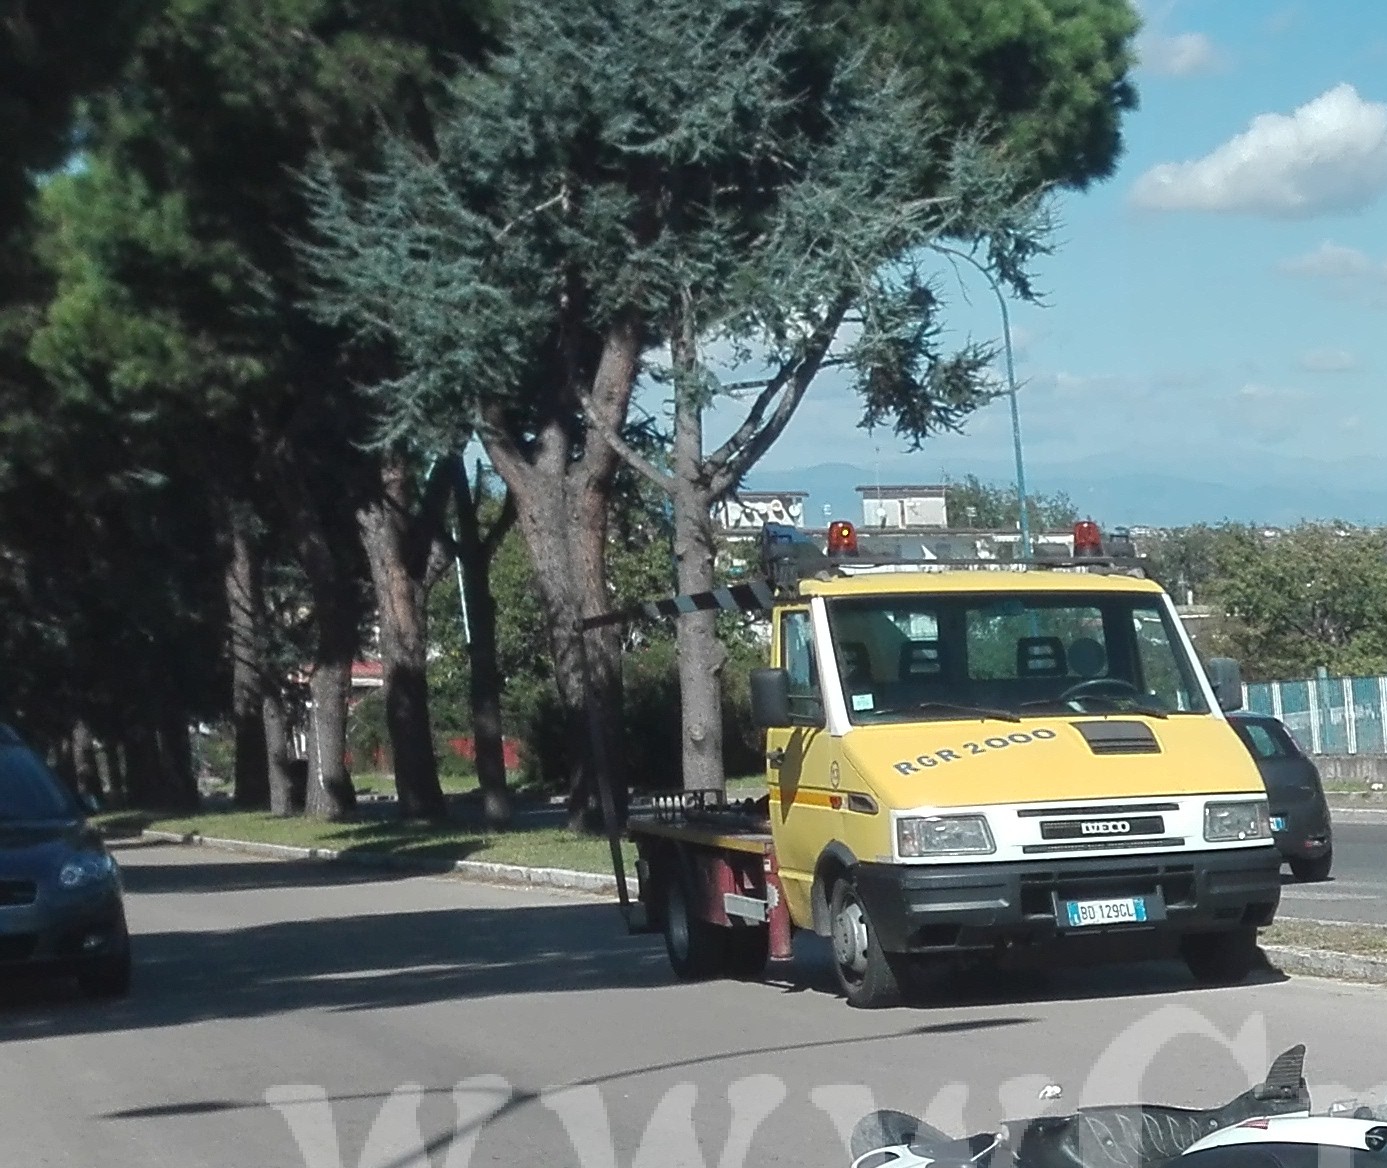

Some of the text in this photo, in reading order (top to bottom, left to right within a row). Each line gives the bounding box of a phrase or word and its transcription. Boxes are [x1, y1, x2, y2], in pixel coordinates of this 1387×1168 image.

[893, 728, 1057, 775] RGR 2000
[1081, 821, 1130, 834] IVECO
